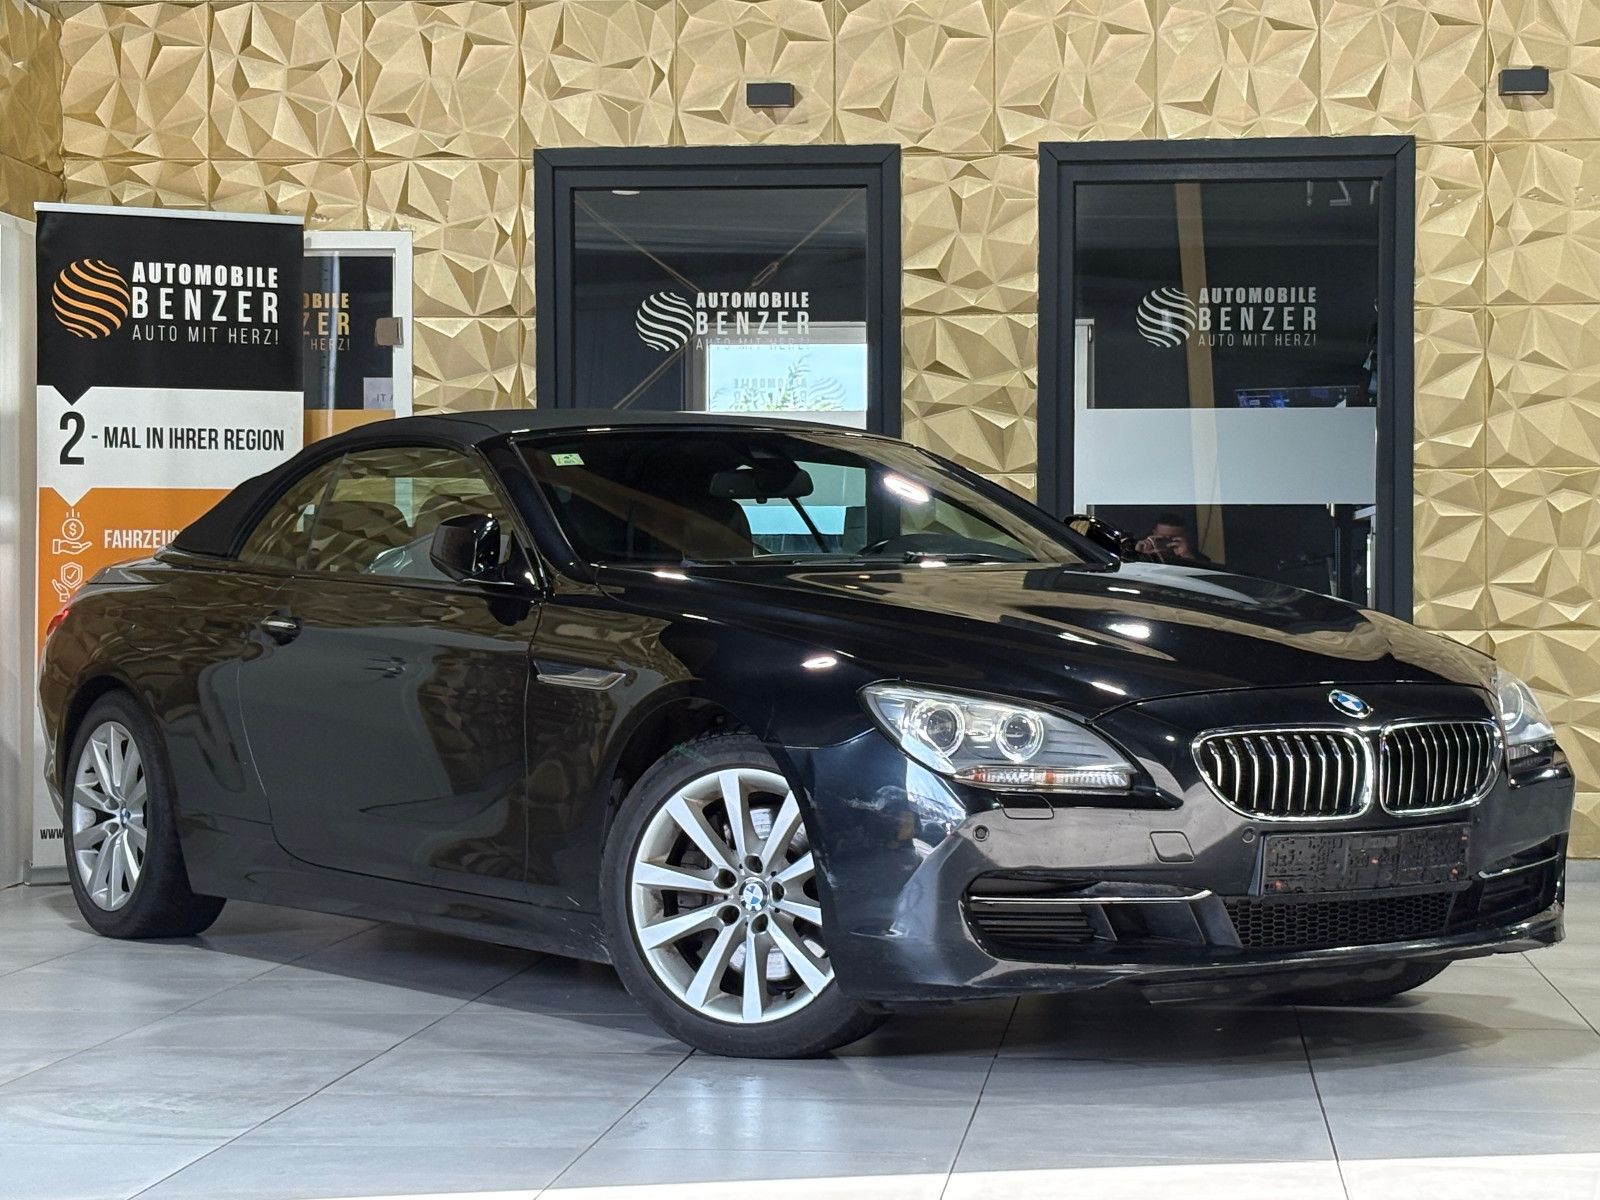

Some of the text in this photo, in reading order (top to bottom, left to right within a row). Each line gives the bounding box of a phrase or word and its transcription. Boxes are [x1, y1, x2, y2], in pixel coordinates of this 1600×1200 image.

[132, 261, 278, 288] AUTOMOBILE
[132, 286, 278, 324] BENZER
[696, 291, 810, 309] AUTOMOBILE
[1198, 286, 1317, 304] AUTOMOBILE
[696, 311, 810, 335] BENZER
[1198, 306, 1317, 331] BENZER
[132, 324, 279, 345] AUTO MIT HERZ!
[1198, 333, 1317, 347] AUTO MIT HERZ!
[104, 426, 142, 449] MAL
[146, 427, 164, 449] IN
[169, 428, 219, 450] IHRER
[224, 429, 285, 451] REGION
